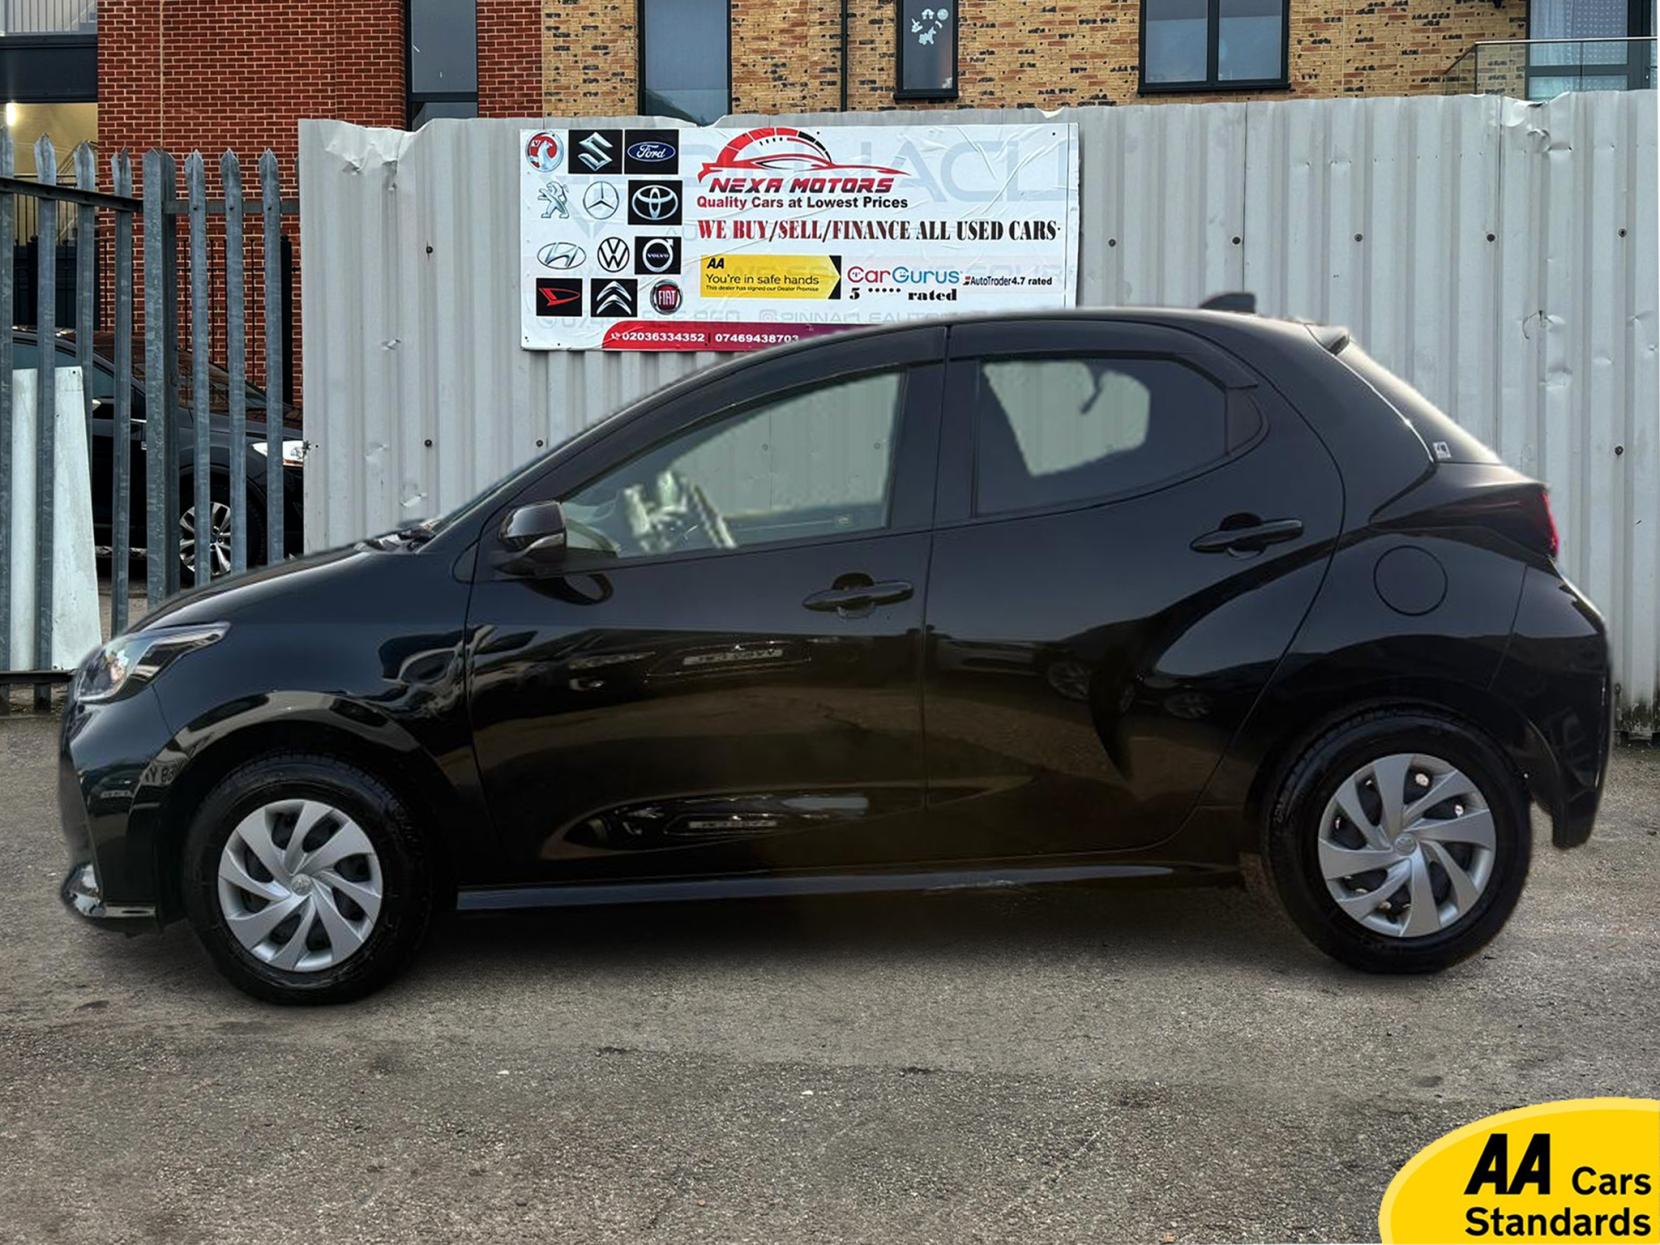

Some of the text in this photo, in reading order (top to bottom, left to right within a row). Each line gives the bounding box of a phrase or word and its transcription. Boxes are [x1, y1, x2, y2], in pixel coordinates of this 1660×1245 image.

[636, 144, 666, 158] Ford
[708, 178, 895, 193] NEXA MOTORS
[697, 196, 908, 210] Quality Cars at Lowest Prices
[698, 219, 1057, 242] WE BUY/SELL/FINANCE ALL USED CARS
[706, 257, 725, 269] AA
[705, 273, 820, 285] You're in safe hands
[847, 266, 960, 284] CarGurus
[1028, 277, 1053, 285] rated
[658, 290, 676, 305] FIAT
[849, 287, 957, 301] 5 rated
[622, 333, 705, 342] 02036334352
